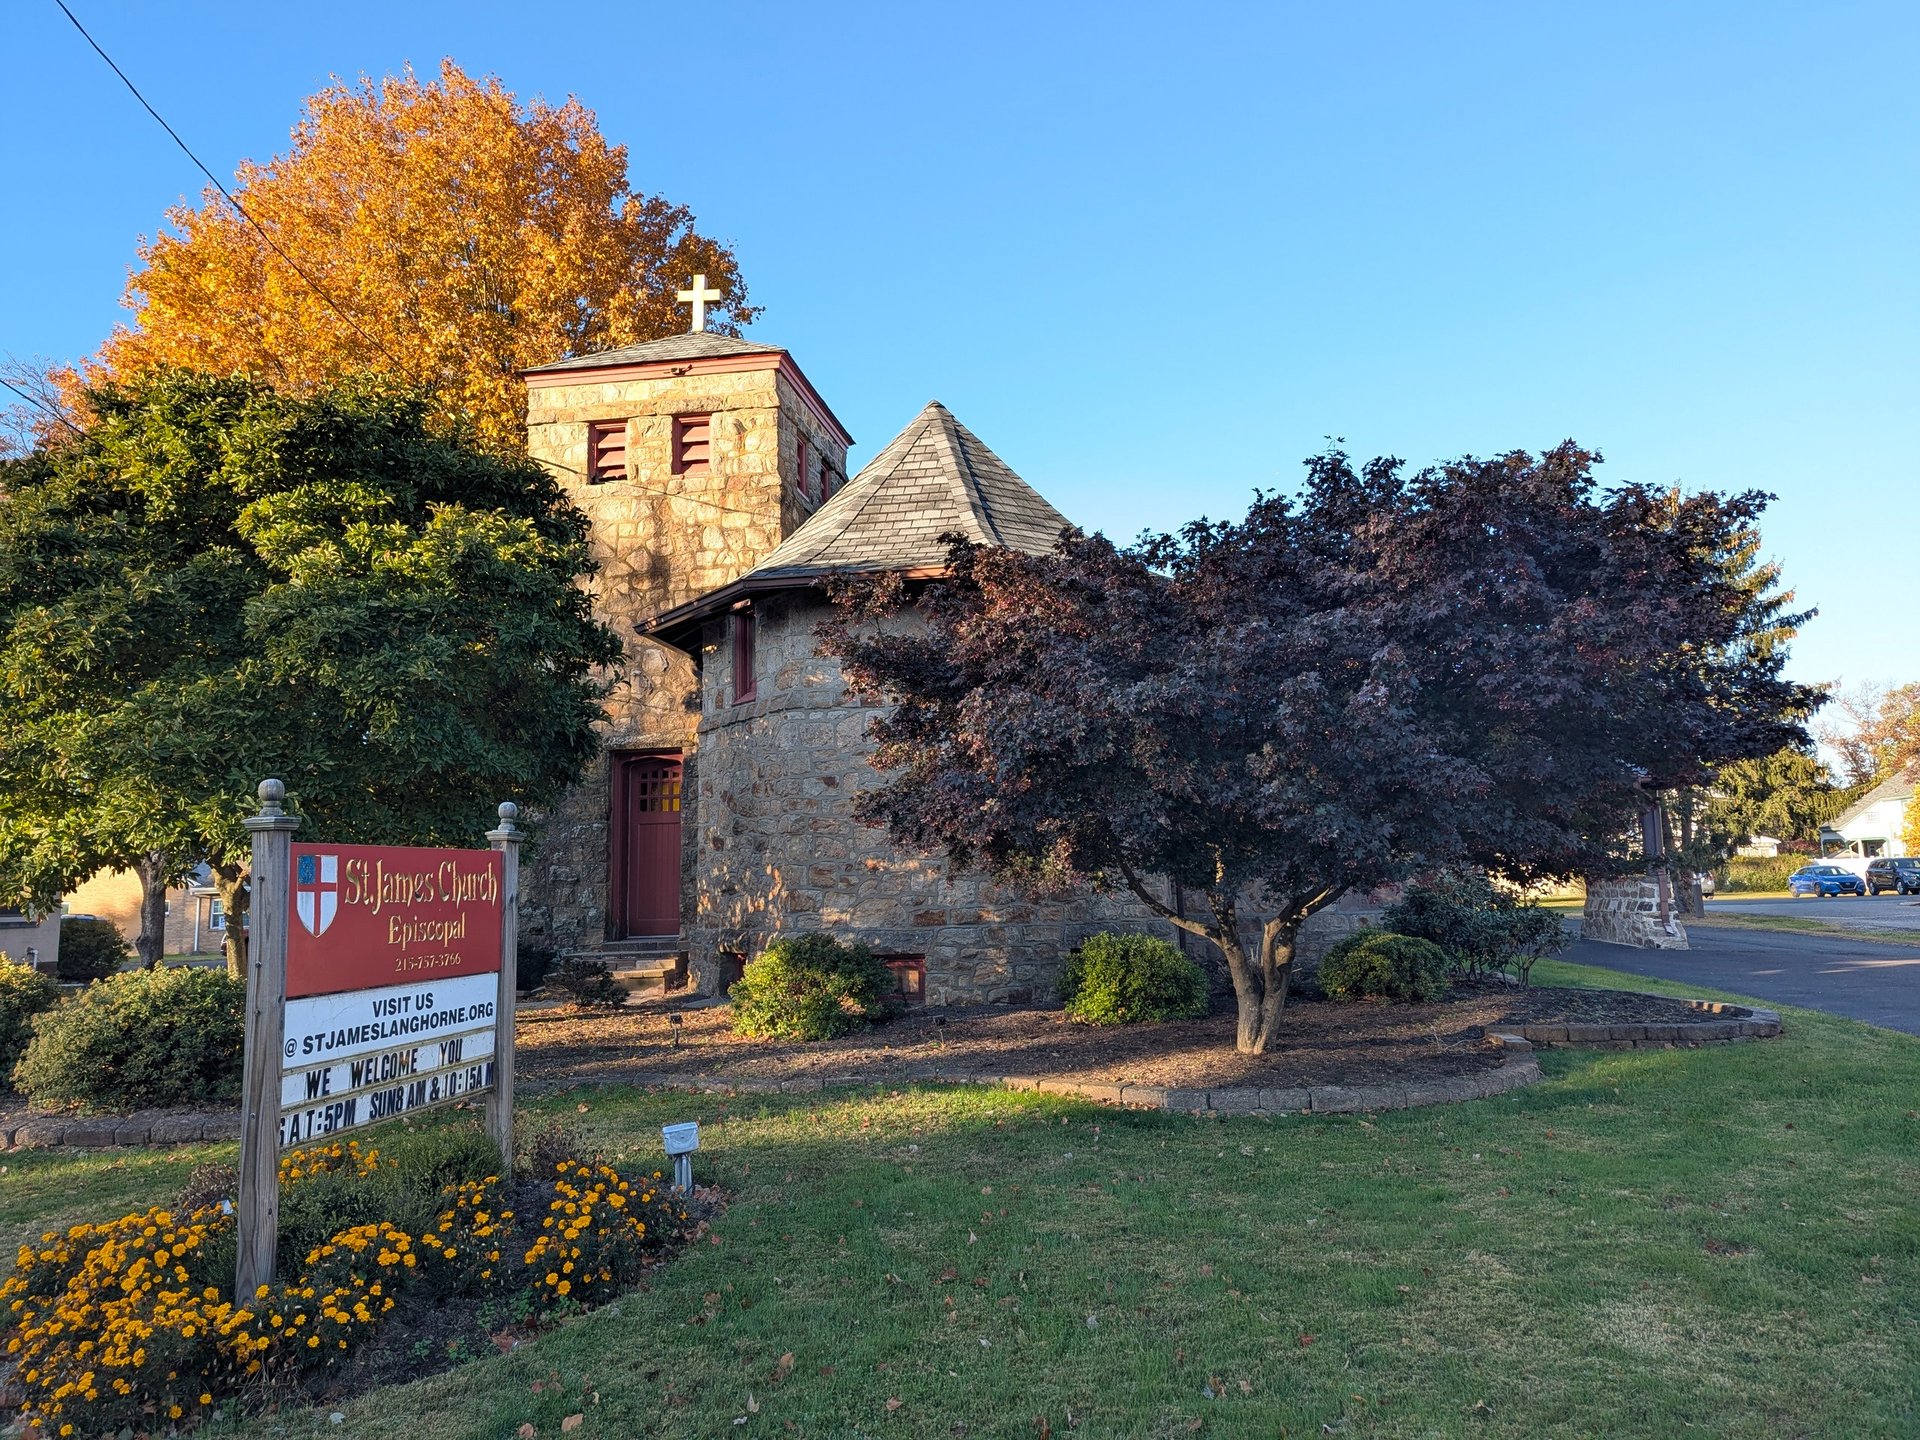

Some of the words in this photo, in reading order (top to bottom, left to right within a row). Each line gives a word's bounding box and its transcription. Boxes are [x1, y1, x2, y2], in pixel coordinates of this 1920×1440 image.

[438, 860, 498, 909] Church
[387, 912, 466, 950] Episcopal
[395, 952, 461, 972] 215-757-3766
[372, 995, 411, 1018] VISIT
[415, 992, 434, 1011] US
[284, 1037, 298, 1058] @
[302, 1001, 493, 1055] STJAMESLANGHORNE.ORG
[306, 1067, 331, 1100] WE
[351, 1048, 419, 1089] WELCOME
[440, 1038, 463, 1067] YOU
[429, 1076, 441, 1101] &
